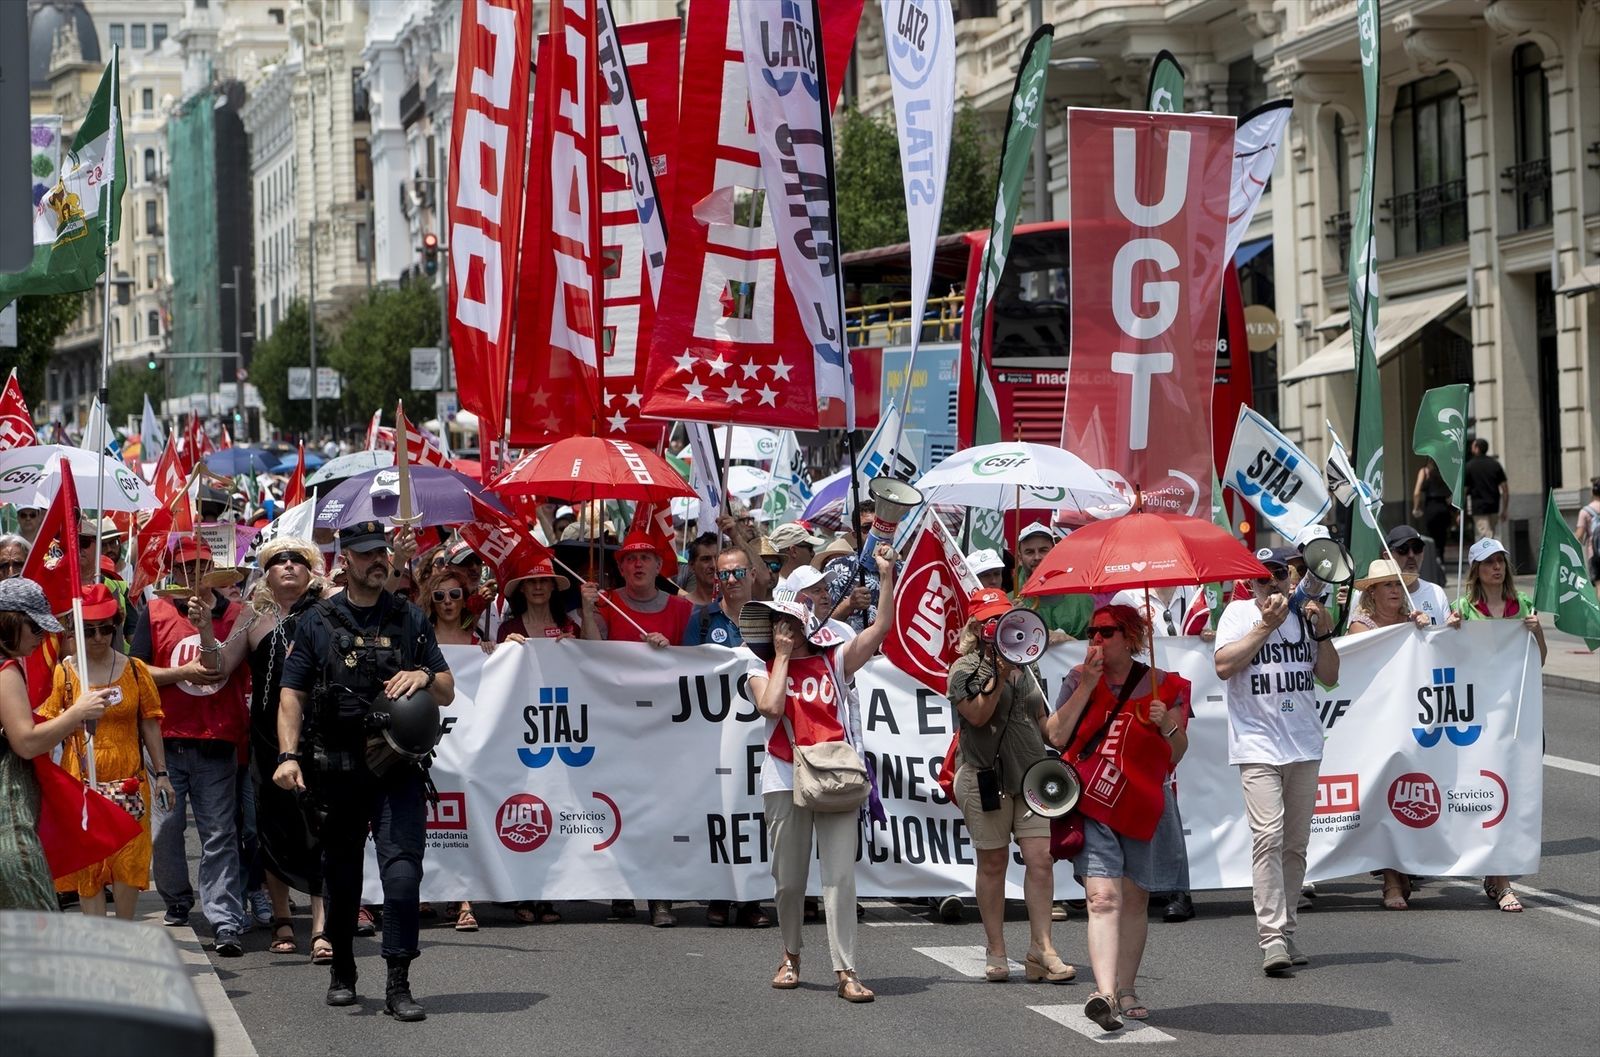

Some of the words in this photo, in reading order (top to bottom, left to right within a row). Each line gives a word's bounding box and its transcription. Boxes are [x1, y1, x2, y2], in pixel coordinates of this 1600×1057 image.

[1110, 127, 1192, 450] UGT
[1247, 450, 1303, 503] STAJ
[1140, 495, 1181, 508] Públicos
[1251, 673, 1271, 695] EN
[1417, 683, 1475, 725] STAJ
[523, 704, 588, 744] STAJ
[1396, 781, 1437, 802] UGT
[1446, 789, 1494, 800] Servicios
[502, 803, 544, 826] UGT
[1447, 801, 1493, 813] Públicos
[559, 811, 606, 821] Servicios
[559, 824, 604, 835] Públicos
[1336, 822, 1360, 834] justicia
[443, 841, 469, 849] justicia
